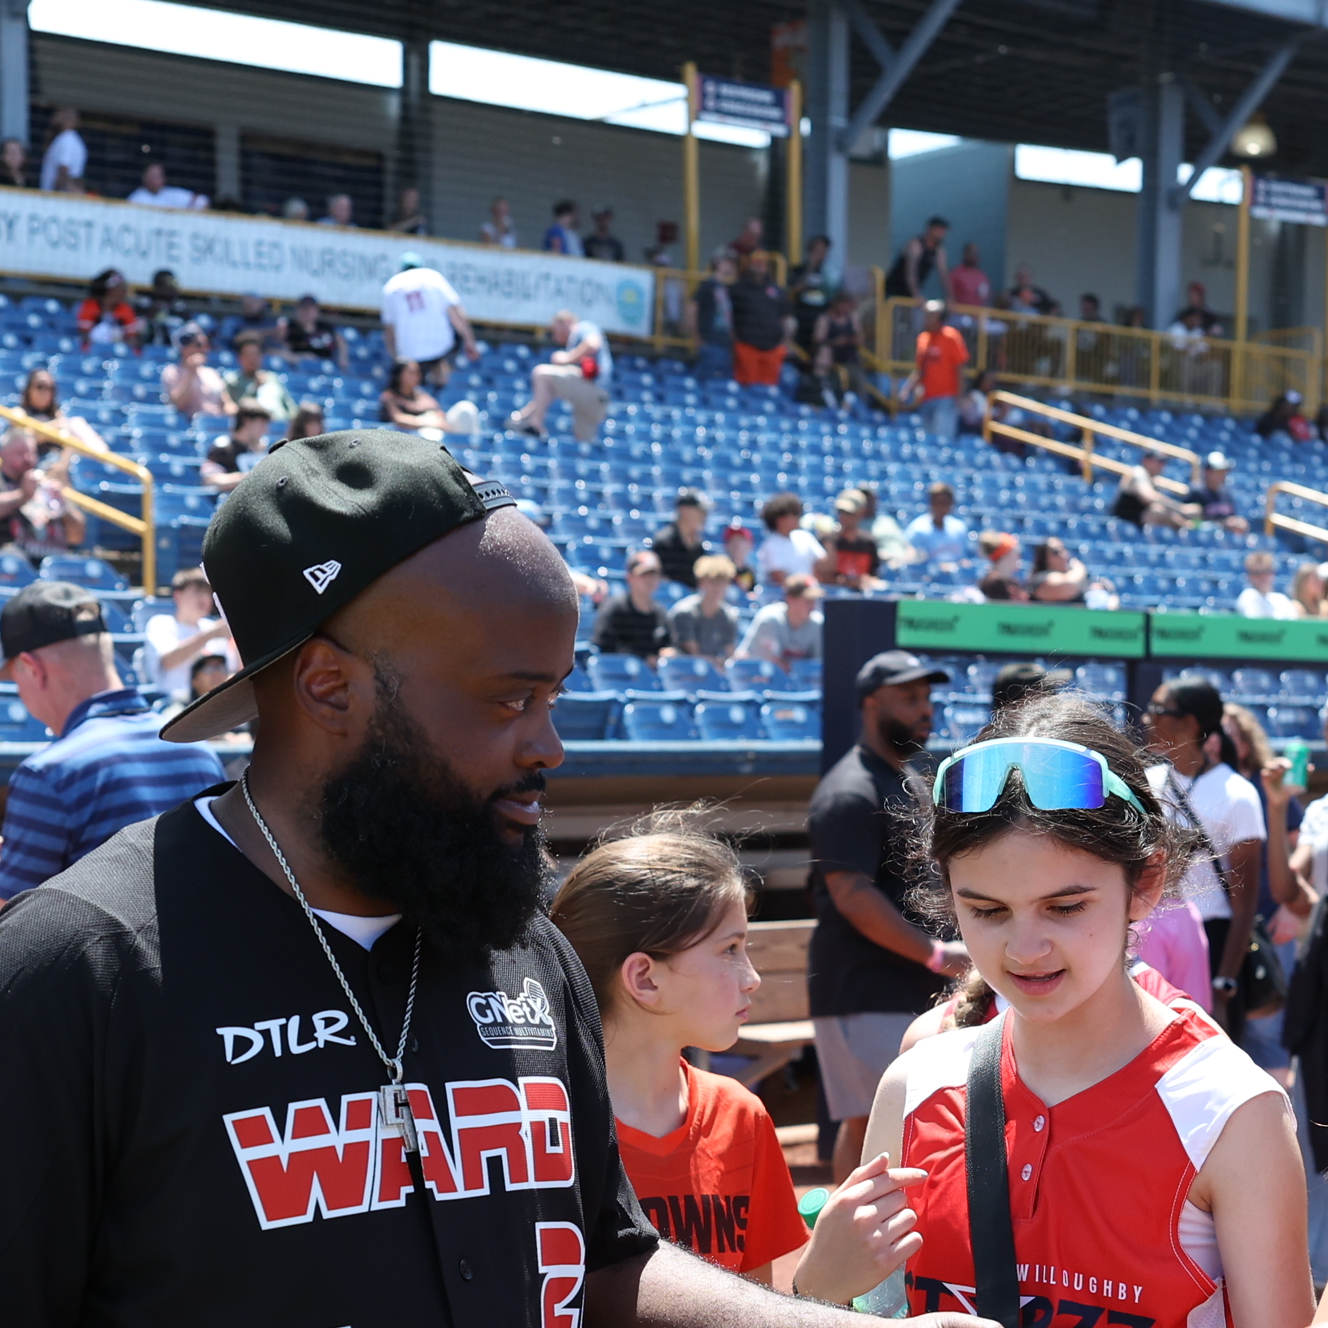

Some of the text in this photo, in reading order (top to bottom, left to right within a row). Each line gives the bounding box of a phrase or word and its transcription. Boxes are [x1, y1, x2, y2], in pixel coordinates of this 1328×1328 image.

[28, 213, 94, 252] POST
[101, 220, 180, 262] ACUTE
[188, 230, 283, 272] SKILLED
[289, 246, 392, 284] NURSING
[447, 260, 612, 305] REHABILITATION
[481, 1025, 555, 1038] SEQUENCE MULTIVITAMINS
[223, 1076, 575, 1231] WARD
[1016, 1263, 1143, 1304] WILLOUGHBY
